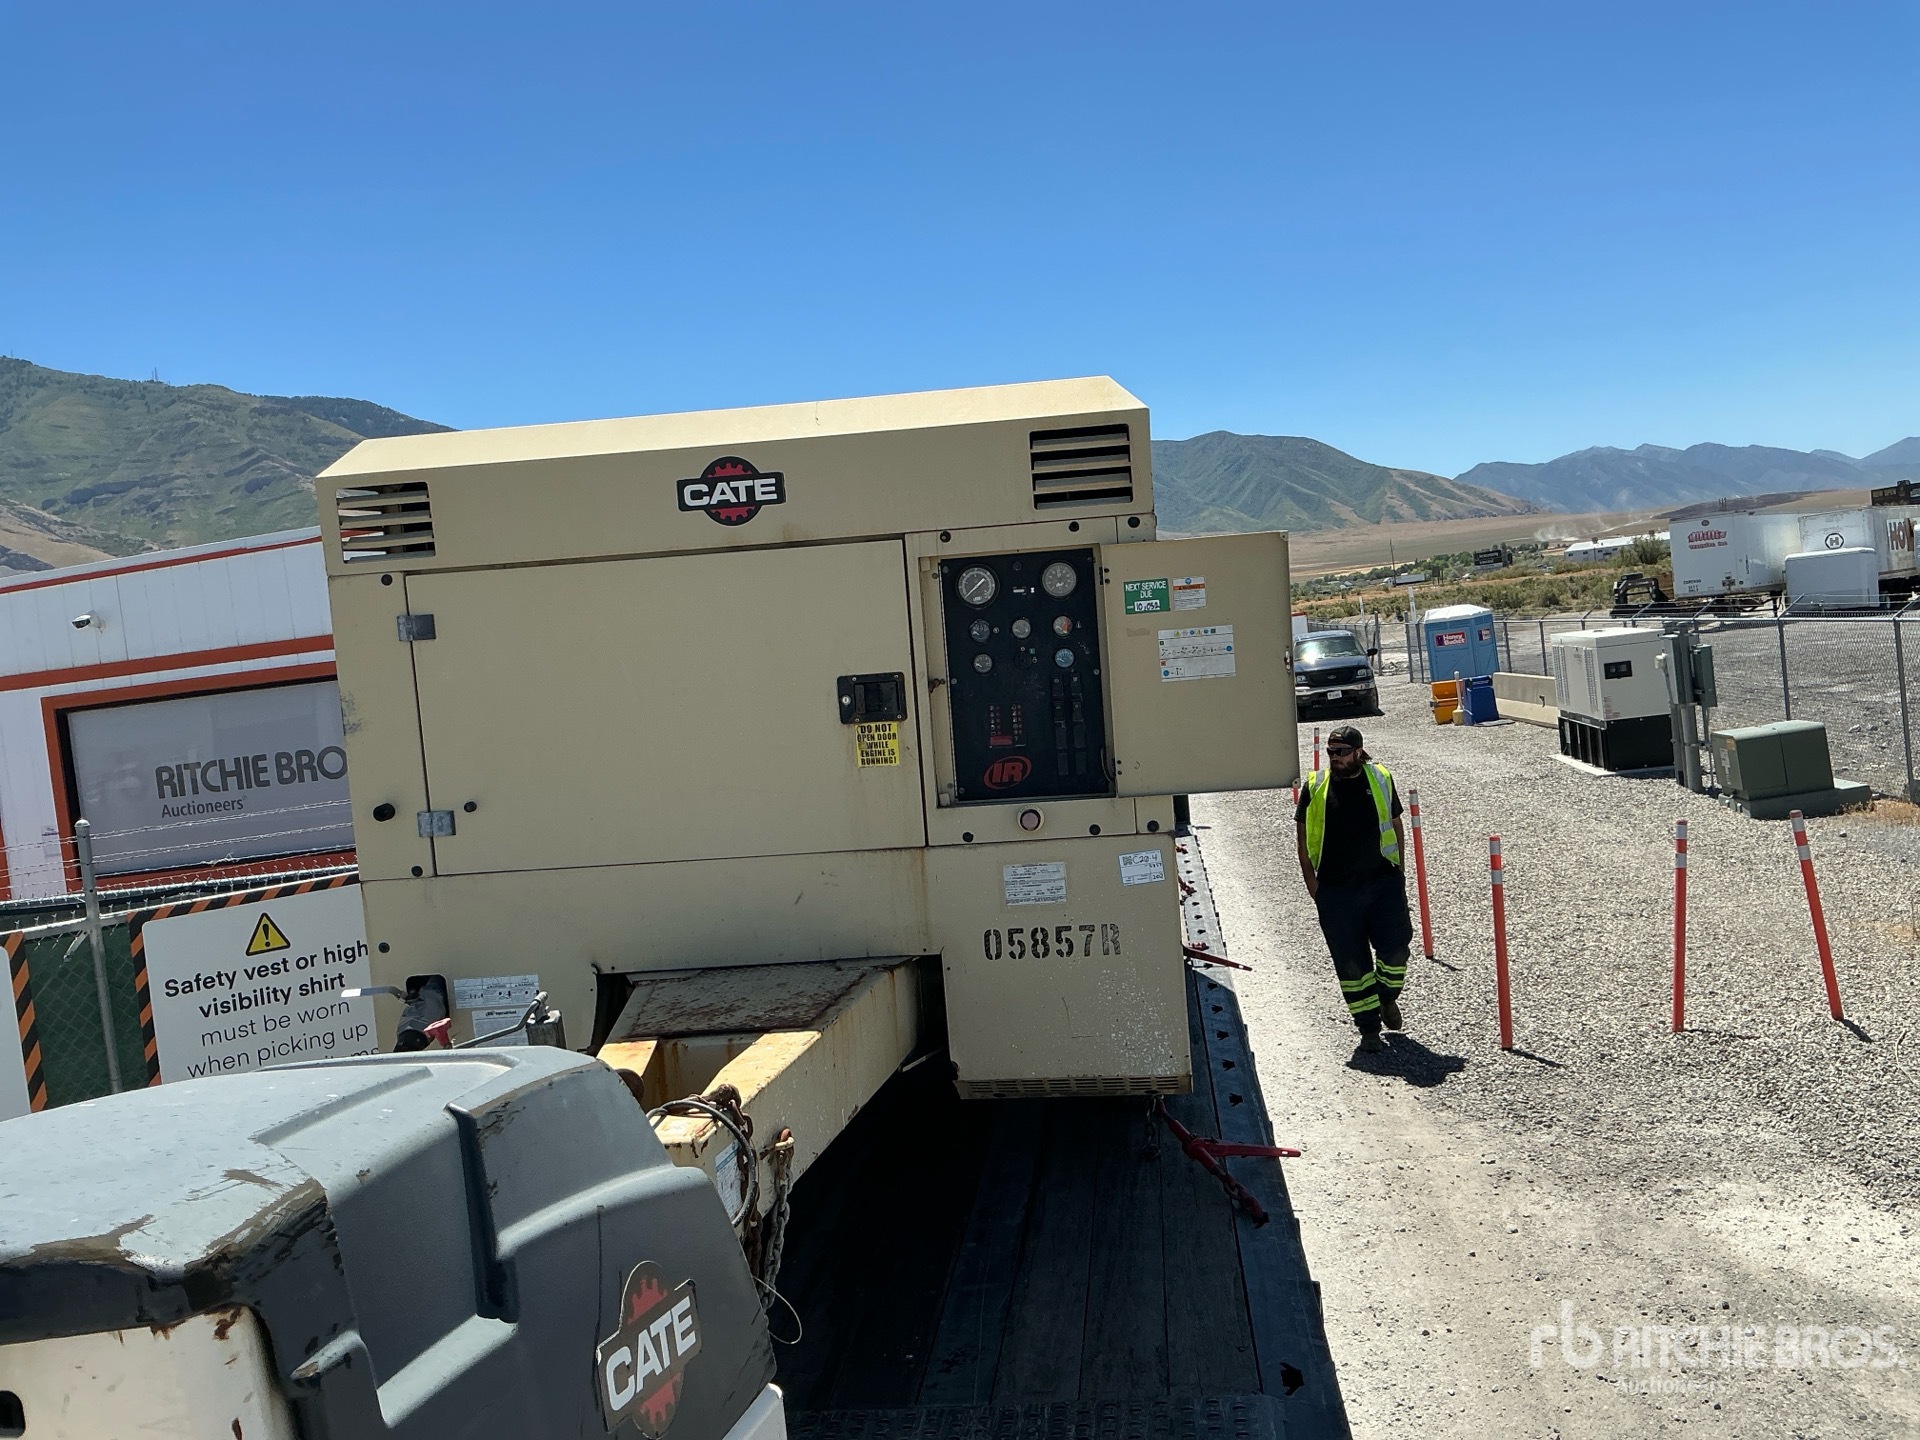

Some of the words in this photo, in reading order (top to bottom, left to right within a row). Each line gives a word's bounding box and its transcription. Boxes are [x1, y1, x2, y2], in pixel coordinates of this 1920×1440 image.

[683, 477, 778, 507] CATE
[1125, 583, 1140, 592] NEXT
[1141, 581, 1167, 590] SERVICE
[1139, 590, 1153, 599] DUE
[857, 734, 875, 742] OPEN
[877, 732, 897, 741] DOOR
[860, 725, 872, 734] DO
[875, 723, 892, 733] NOT
[861, 749, 887, 757] ENGINE
[888, 748, 896, 756] IS
[867, 741, 889, 750] WHILE
[861, 756, 897, 765] RUNNING!
[155, 753, 271, 800] RITCHIE
[161, 798, 244, 819] Auctioneers
[983, 923, 1121, 961] 05857R
[164, 970, 237, 998] Safety
[243, 957, 290, 981] vest
[295, 953, 317, 970] or
[323, 940, 369, 965] high
[198, 986, 292, 1018] visibility
[298, 972, 346, 997] shirt
[201, 1019, 257, 1047] must
[263, 1014, 291, 1032] be
[296, 1001, 350, 1024] worn
[187, 1051, 250, 1078] when
[257, 1031, 336, 1066] picking
[342, 1023, 369, 1043] up
[605, 1295, 697, 1412] CATE
